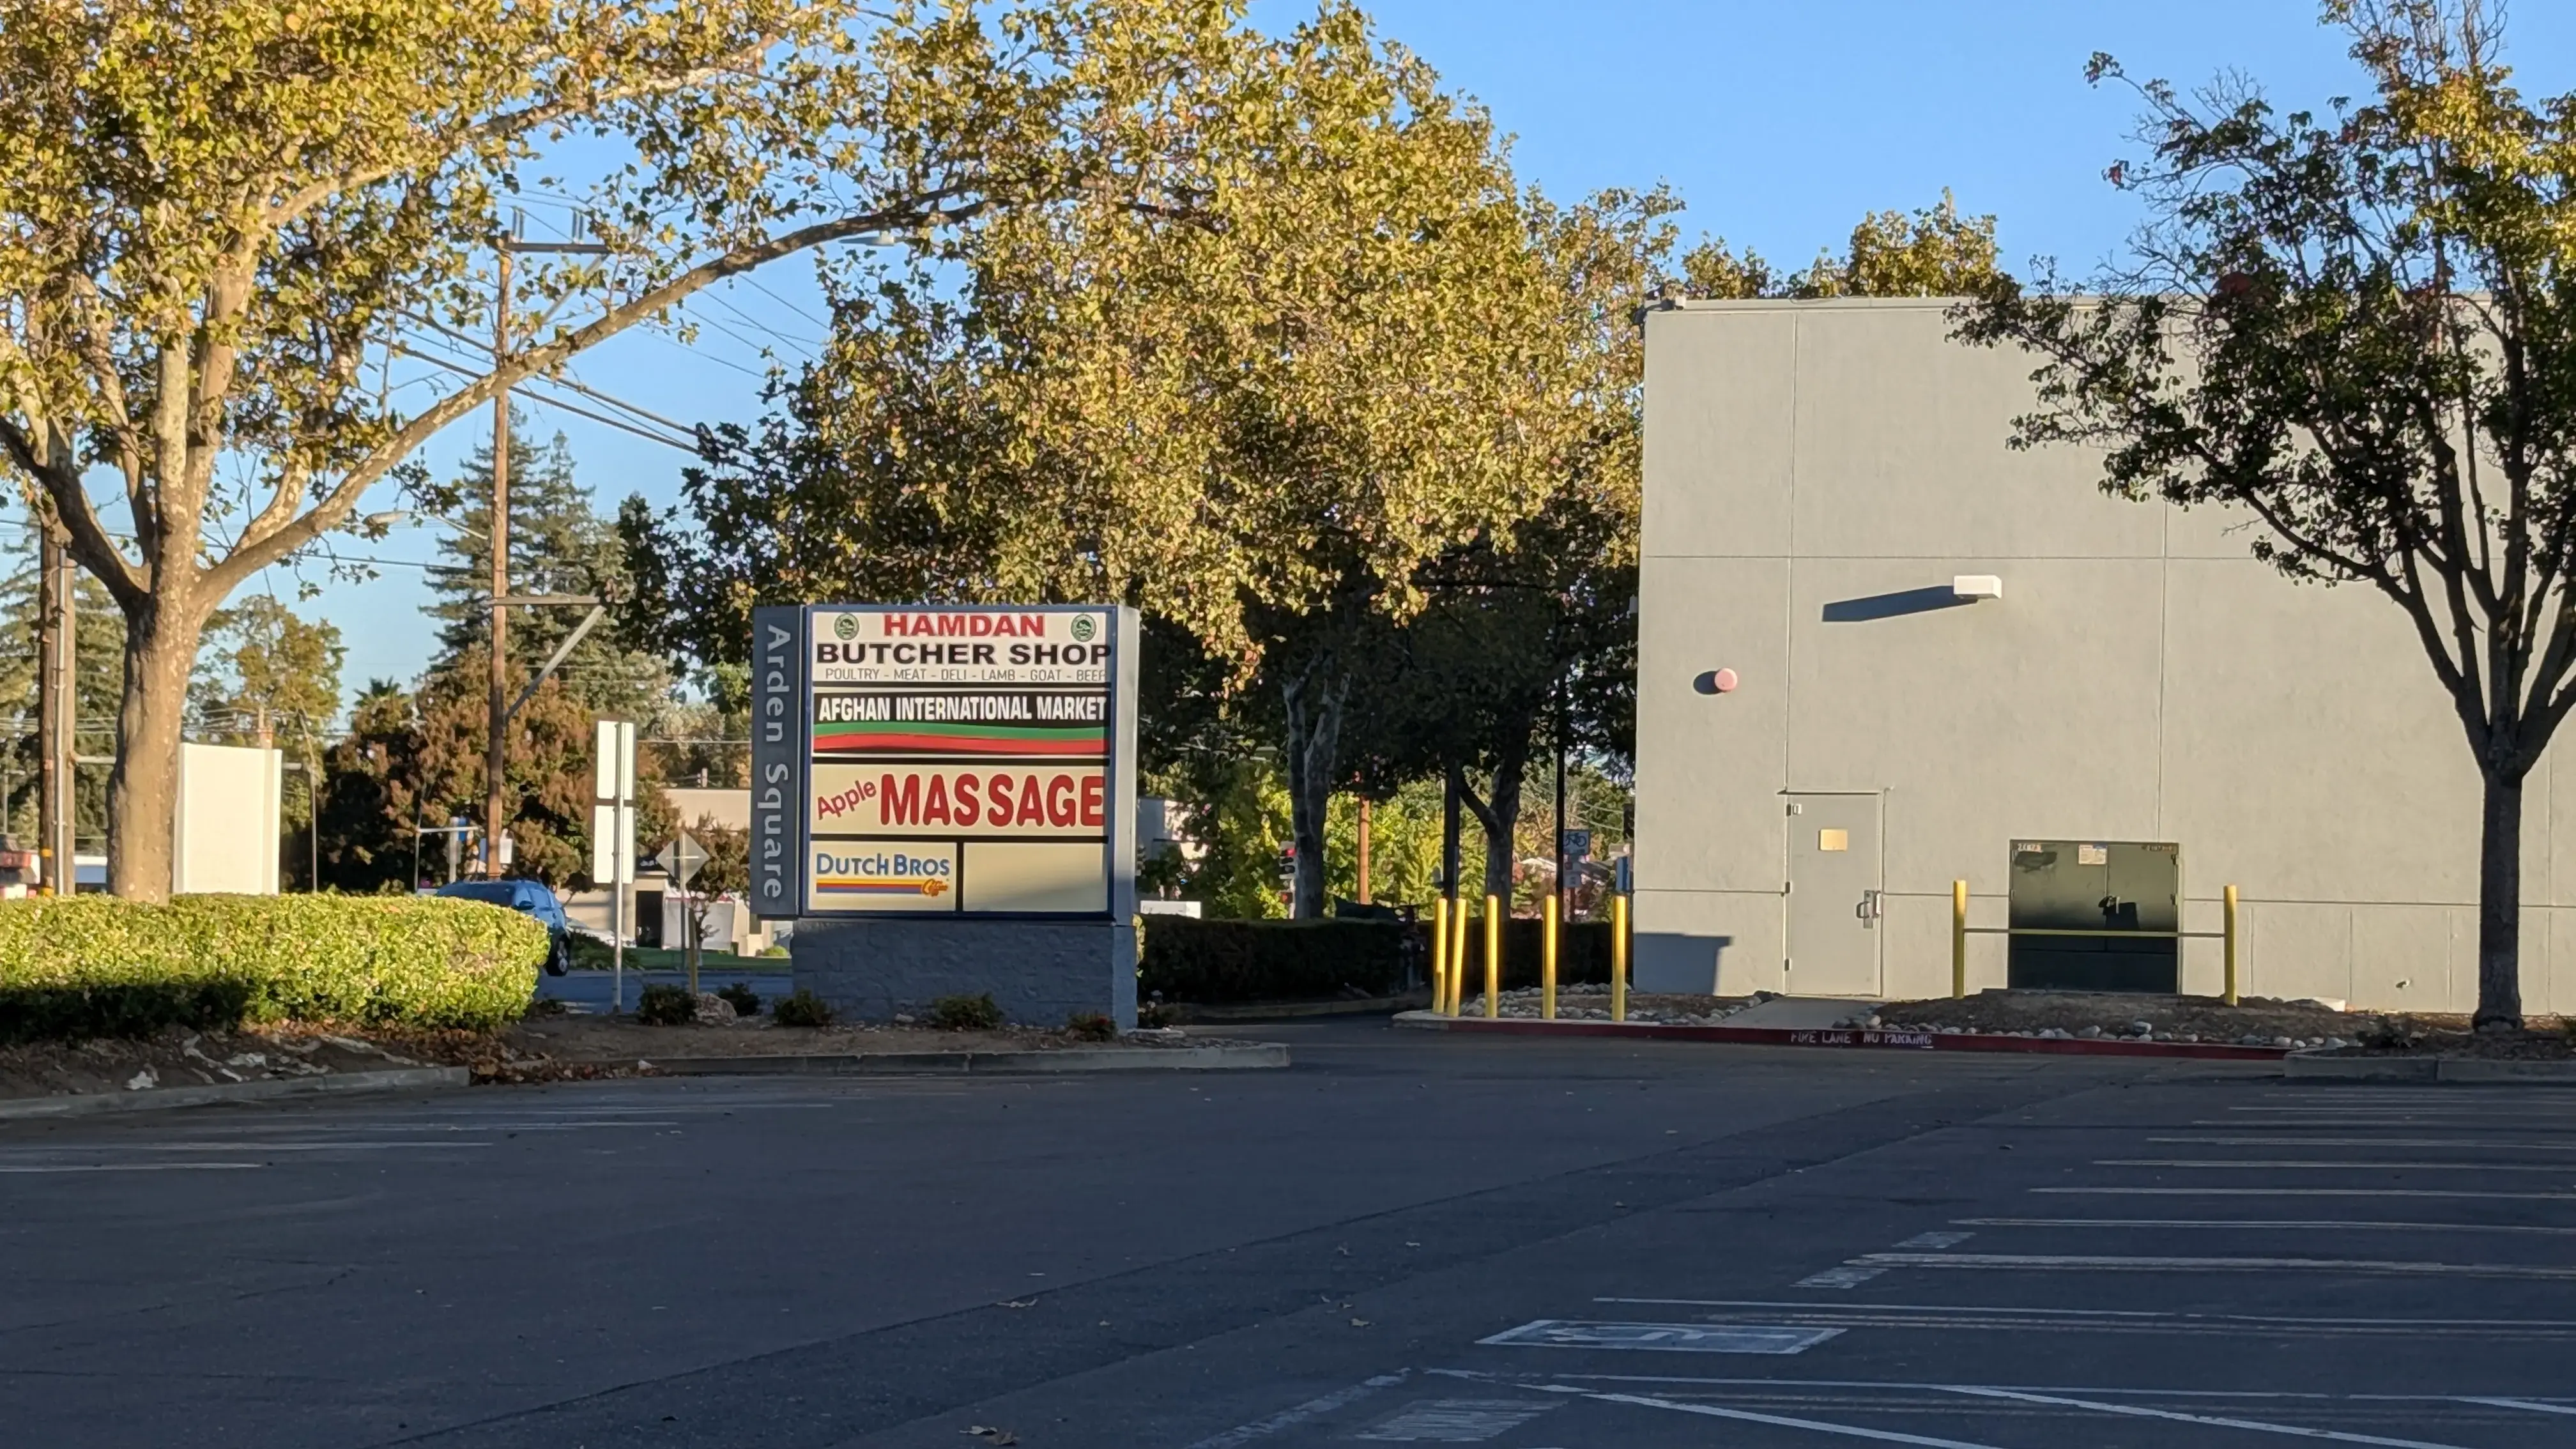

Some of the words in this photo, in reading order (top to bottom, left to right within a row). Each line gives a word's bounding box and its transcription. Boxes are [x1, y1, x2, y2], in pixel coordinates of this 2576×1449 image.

[884, 614, 1045, 637] HAMDAN
[816, 643, 997, 664] BUTCHER
[1009, 644, 1112, 665] SHOP
[766, 625, 790, 742] Arden
[825, 668, 880, 680] POULTRY
[894, 668, 926, 680] MEAT
[941, 669, 967, 680] DELI
[981, 669, 1015, 680] LAMB
[1030, 669, 1062, 681] GOAT
[818, 697, 890, 721] AFGHAN
[896, 696, 1032, 720] INTERNATIONAL
[1036, 696, 1107, 720] MARKET
[817, 779, 877, 820] Apple
[880, 773, 1105, 827] MASSAGE
[757, 763, 788, 898] Square
[894, 854, 950, 876] BROS
[1791, 1032, 1816, 1043] FIRE
[1821, 1032, 1851, 1044] LANE
[1863, 1032, 1878, 1043] NO
[1884, 1033, 1932, 1045] PARKING
